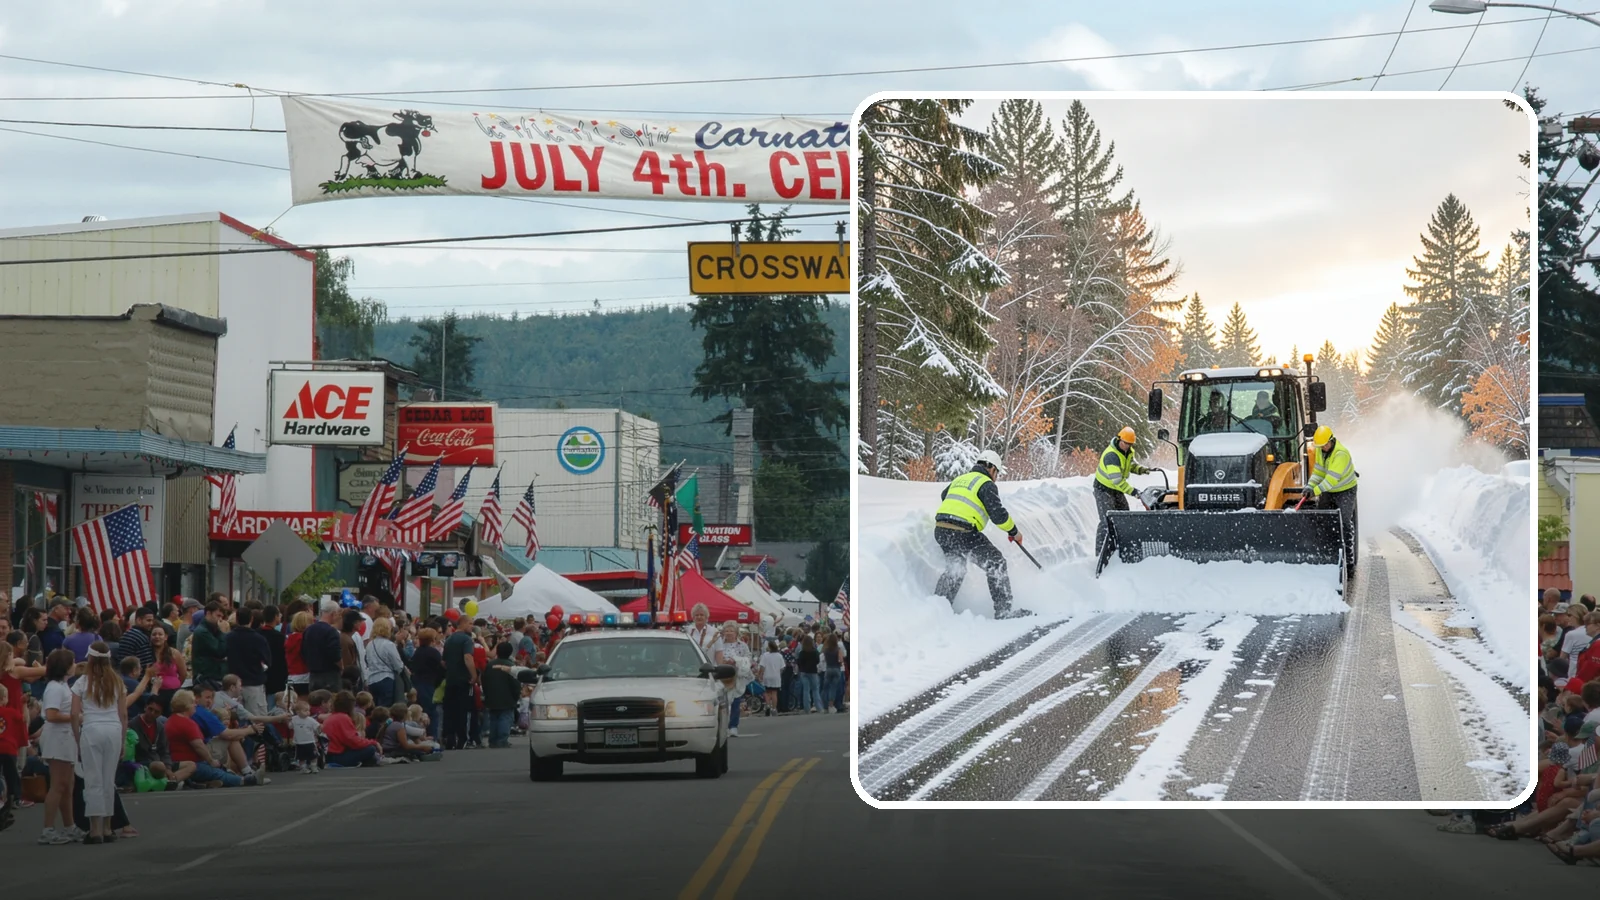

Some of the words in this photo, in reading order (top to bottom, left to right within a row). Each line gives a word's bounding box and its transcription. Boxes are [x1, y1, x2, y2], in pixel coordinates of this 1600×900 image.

[694, 121, 851, 149] Carnat
[481, 141, 605, 192] JULY
[632, 150, 747, 198] 4th.
[696, 254, 851, 280] CROSSWA
[282, 379, 374, 420] ACE
[405, 409, 453, 422] CEDAR
[283, 420, 371, 437] Hardware
[83, 484, 94, 494] St.
[95, 485, 124, 495] Vincent
[126, 485, 136, 495] de
[137, 485, 155, 495] Paul
[688, 526, 741, 535] CRNATION
[699, 535, 730, 543] GLASS
